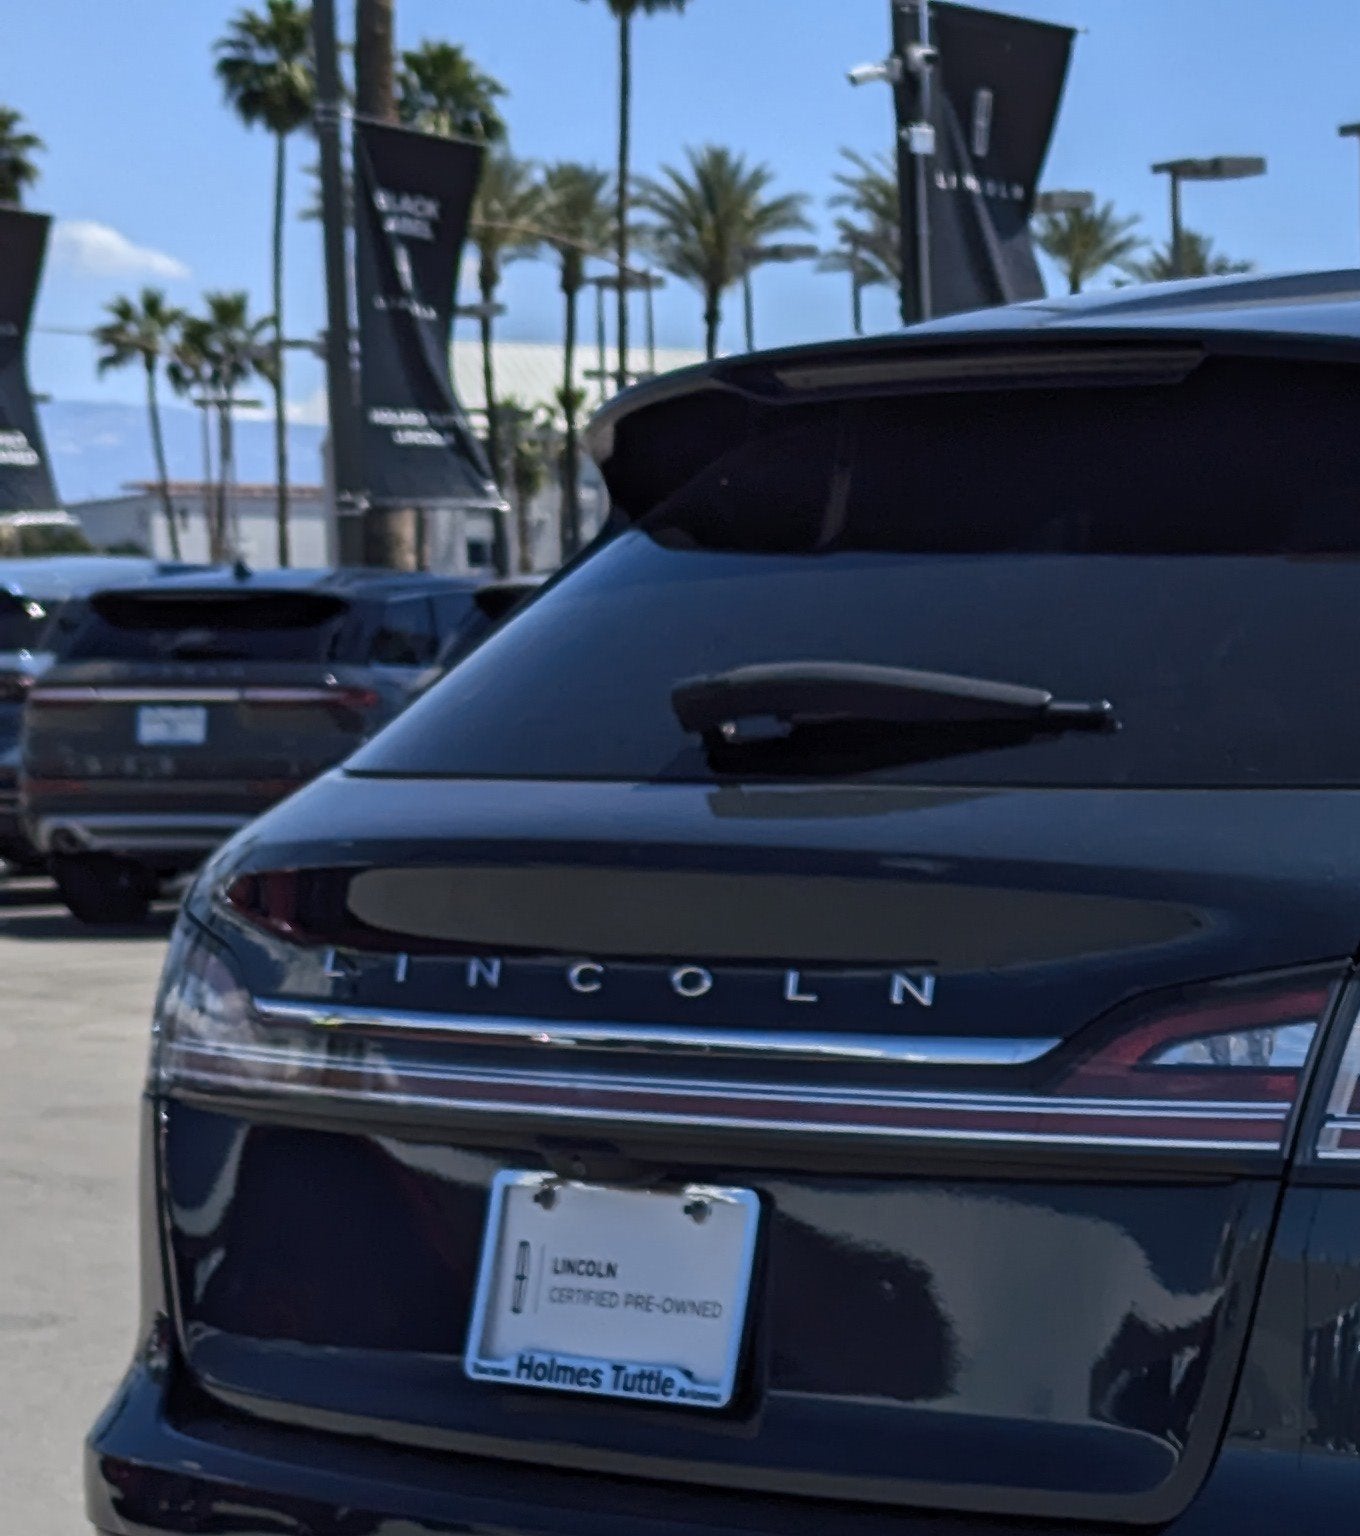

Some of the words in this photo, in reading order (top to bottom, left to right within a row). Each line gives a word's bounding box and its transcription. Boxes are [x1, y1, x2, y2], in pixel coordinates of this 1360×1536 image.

[323, 946, 937, 1006] LINCOLN
[552, 1257, 618, 1279] LINCOLN
[549, 1286, 619, 1309] CERTIFIED
[624, 1292, 723, 1319] PRE-OWNED
[515, 1353, 604, 1389] Holmes
[611, 1364, 676, 1397] Tuttle
